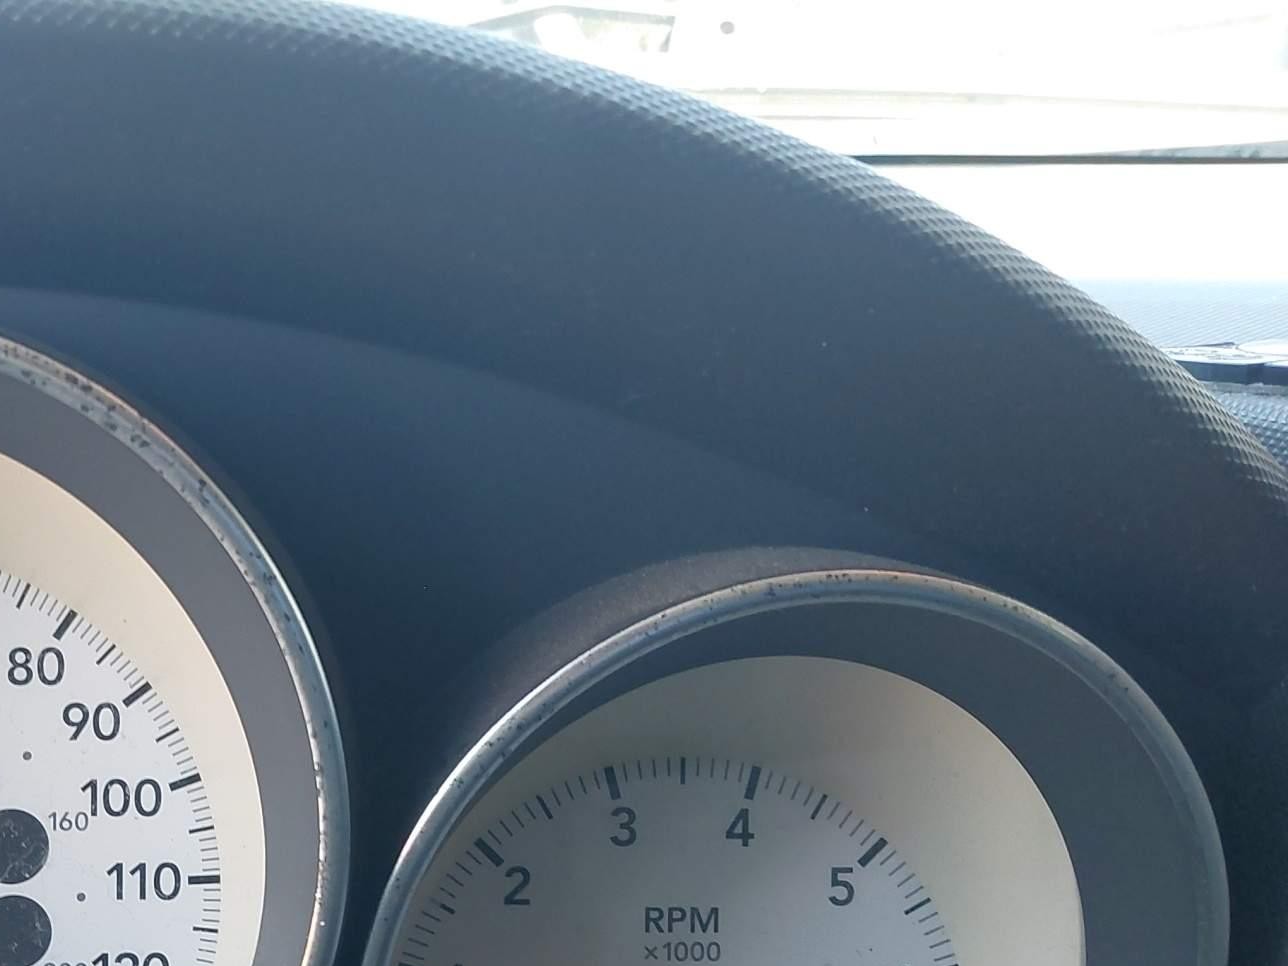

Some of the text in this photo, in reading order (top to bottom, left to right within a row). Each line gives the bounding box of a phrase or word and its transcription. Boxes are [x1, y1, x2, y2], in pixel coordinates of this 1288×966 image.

[7, 647, 64, 686] 80
[62, 703, 120, 741] 90
[81, 778, 161, 817] 100
[49, 812, 88, 831] 160
[610, 807, 637, 847] 3
[725, 808, 754, 846] 4
[107, 862, 181, 900] 110
[503, 866, 530, 906] 2
[829, 867, 855, 906] 5
[644, 906, 719, 933] RPM
